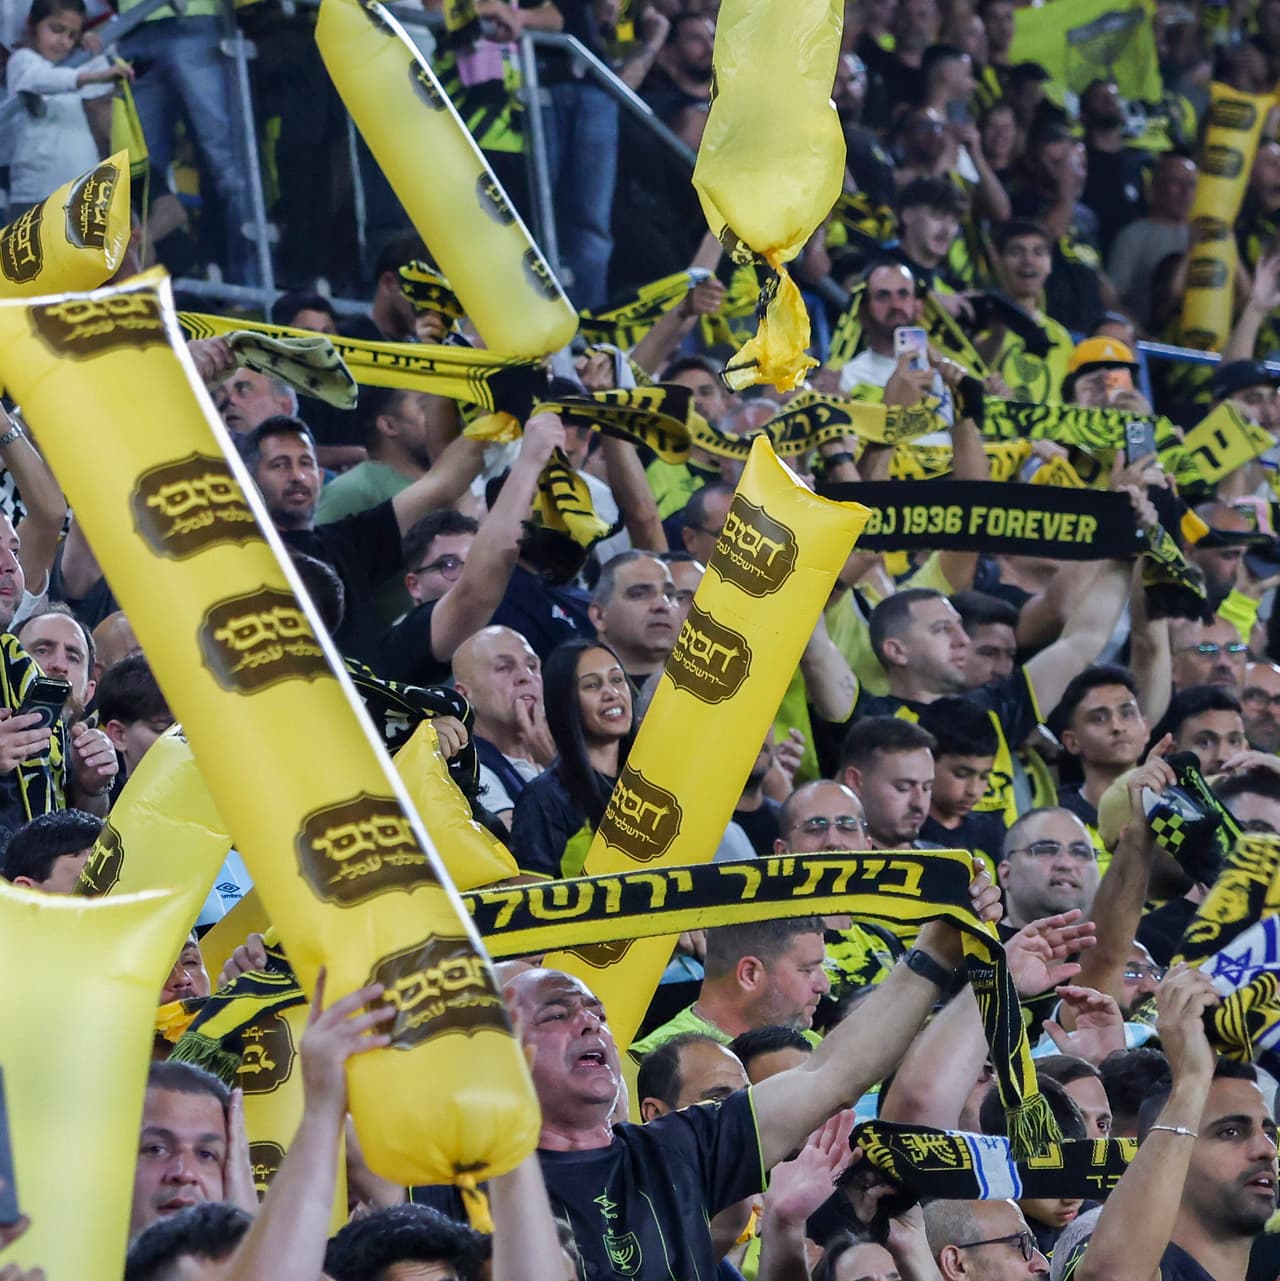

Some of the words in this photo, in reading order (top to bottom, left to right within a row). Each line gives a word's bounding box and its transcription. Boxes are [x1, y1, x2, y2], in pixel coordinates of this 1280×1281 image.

[722, 511, 786, 568] חביב
[902, 505, 964, 535] 1936
[968, 506, 1099, 544] FOREVER
[462, 870, 694, 929] ירושלי
[719, 858, 925, 900] בית"ר
